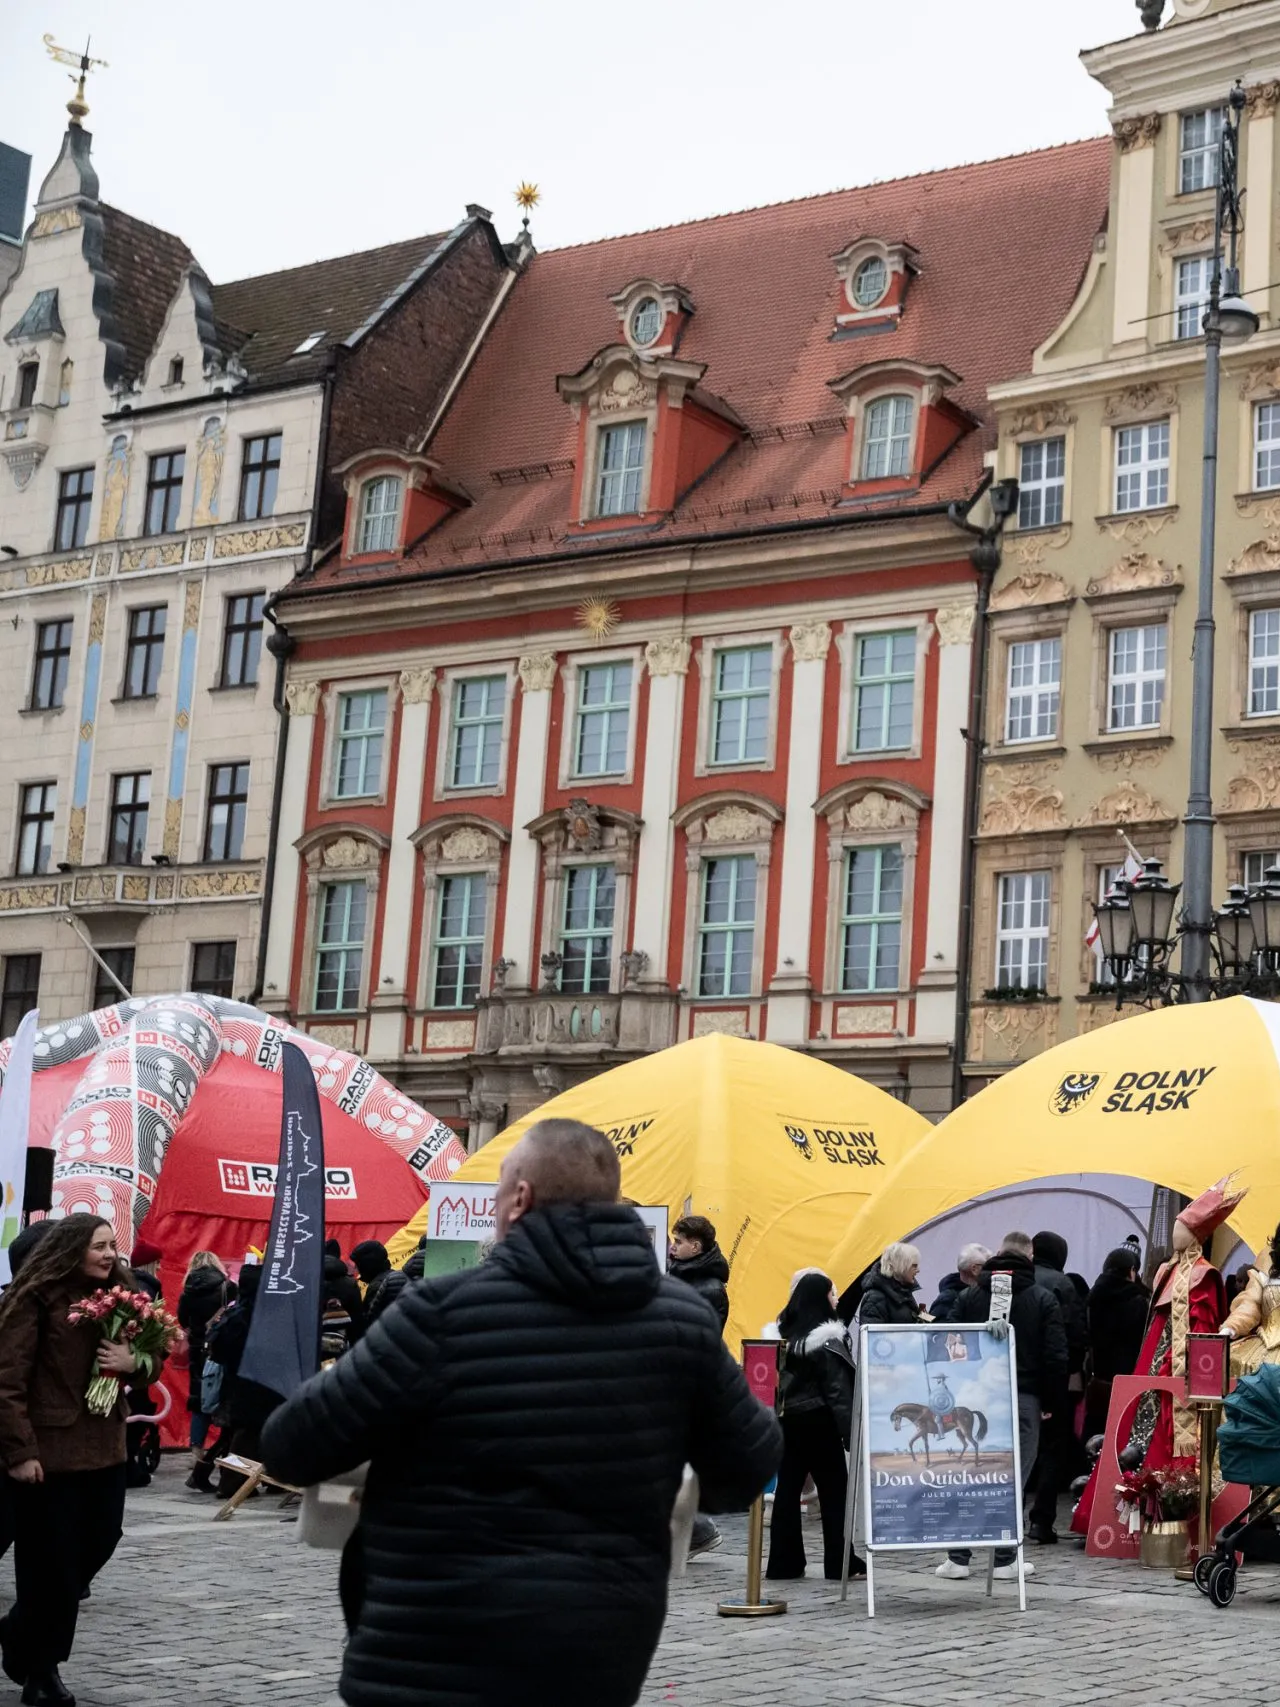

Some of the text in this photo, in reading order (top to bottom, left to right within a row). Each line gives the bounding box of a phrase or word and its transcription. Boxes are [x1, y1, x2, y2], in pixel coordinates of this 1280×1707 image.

[1113, 1066, 1217, 1090] DOLNY
[1101, 1088, 1198, 1115] ŚLĄSK
[604, 1119, 656, 1142] OLNY
[813, 1128, 877, 1147] DOLNY
[823, 1144, 886, 1168] ŚLĄSK
[875, 1469, 1009, 1489] Don Quichotte
